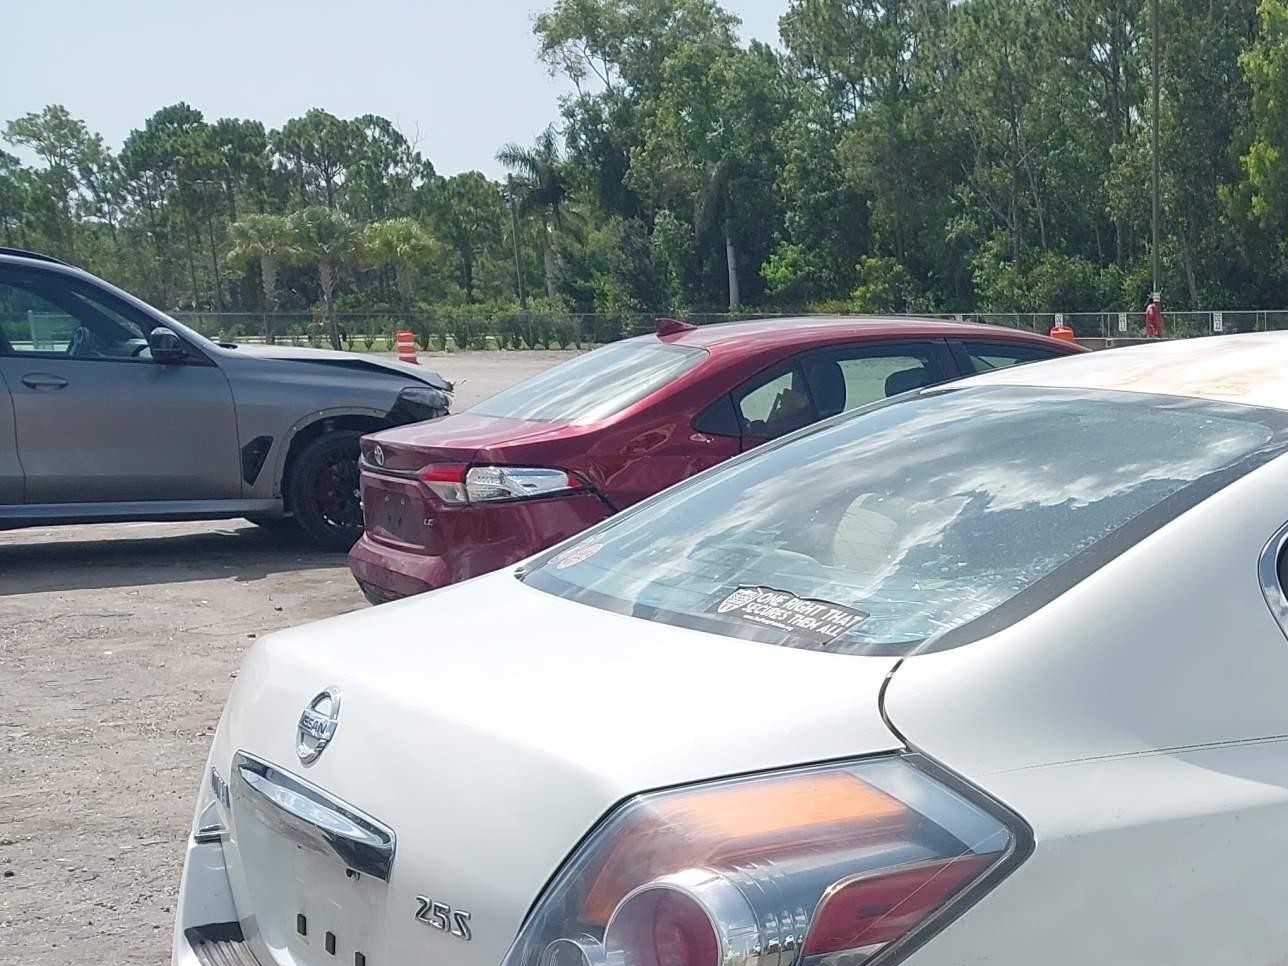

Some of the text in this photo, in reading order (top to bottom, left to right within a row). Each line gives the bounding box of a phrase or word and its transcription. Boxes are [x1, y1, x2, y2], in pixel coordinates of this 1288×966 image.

[743, 602, 791, 620] SECURES
[788, 612, 821, 631] THEM
[816, 623, 845, 637] ALL
[757, 592, 787, 607] ONE
[783, 597, 824, 617] RIGHT
[822, 607, 862, 628] THAT
